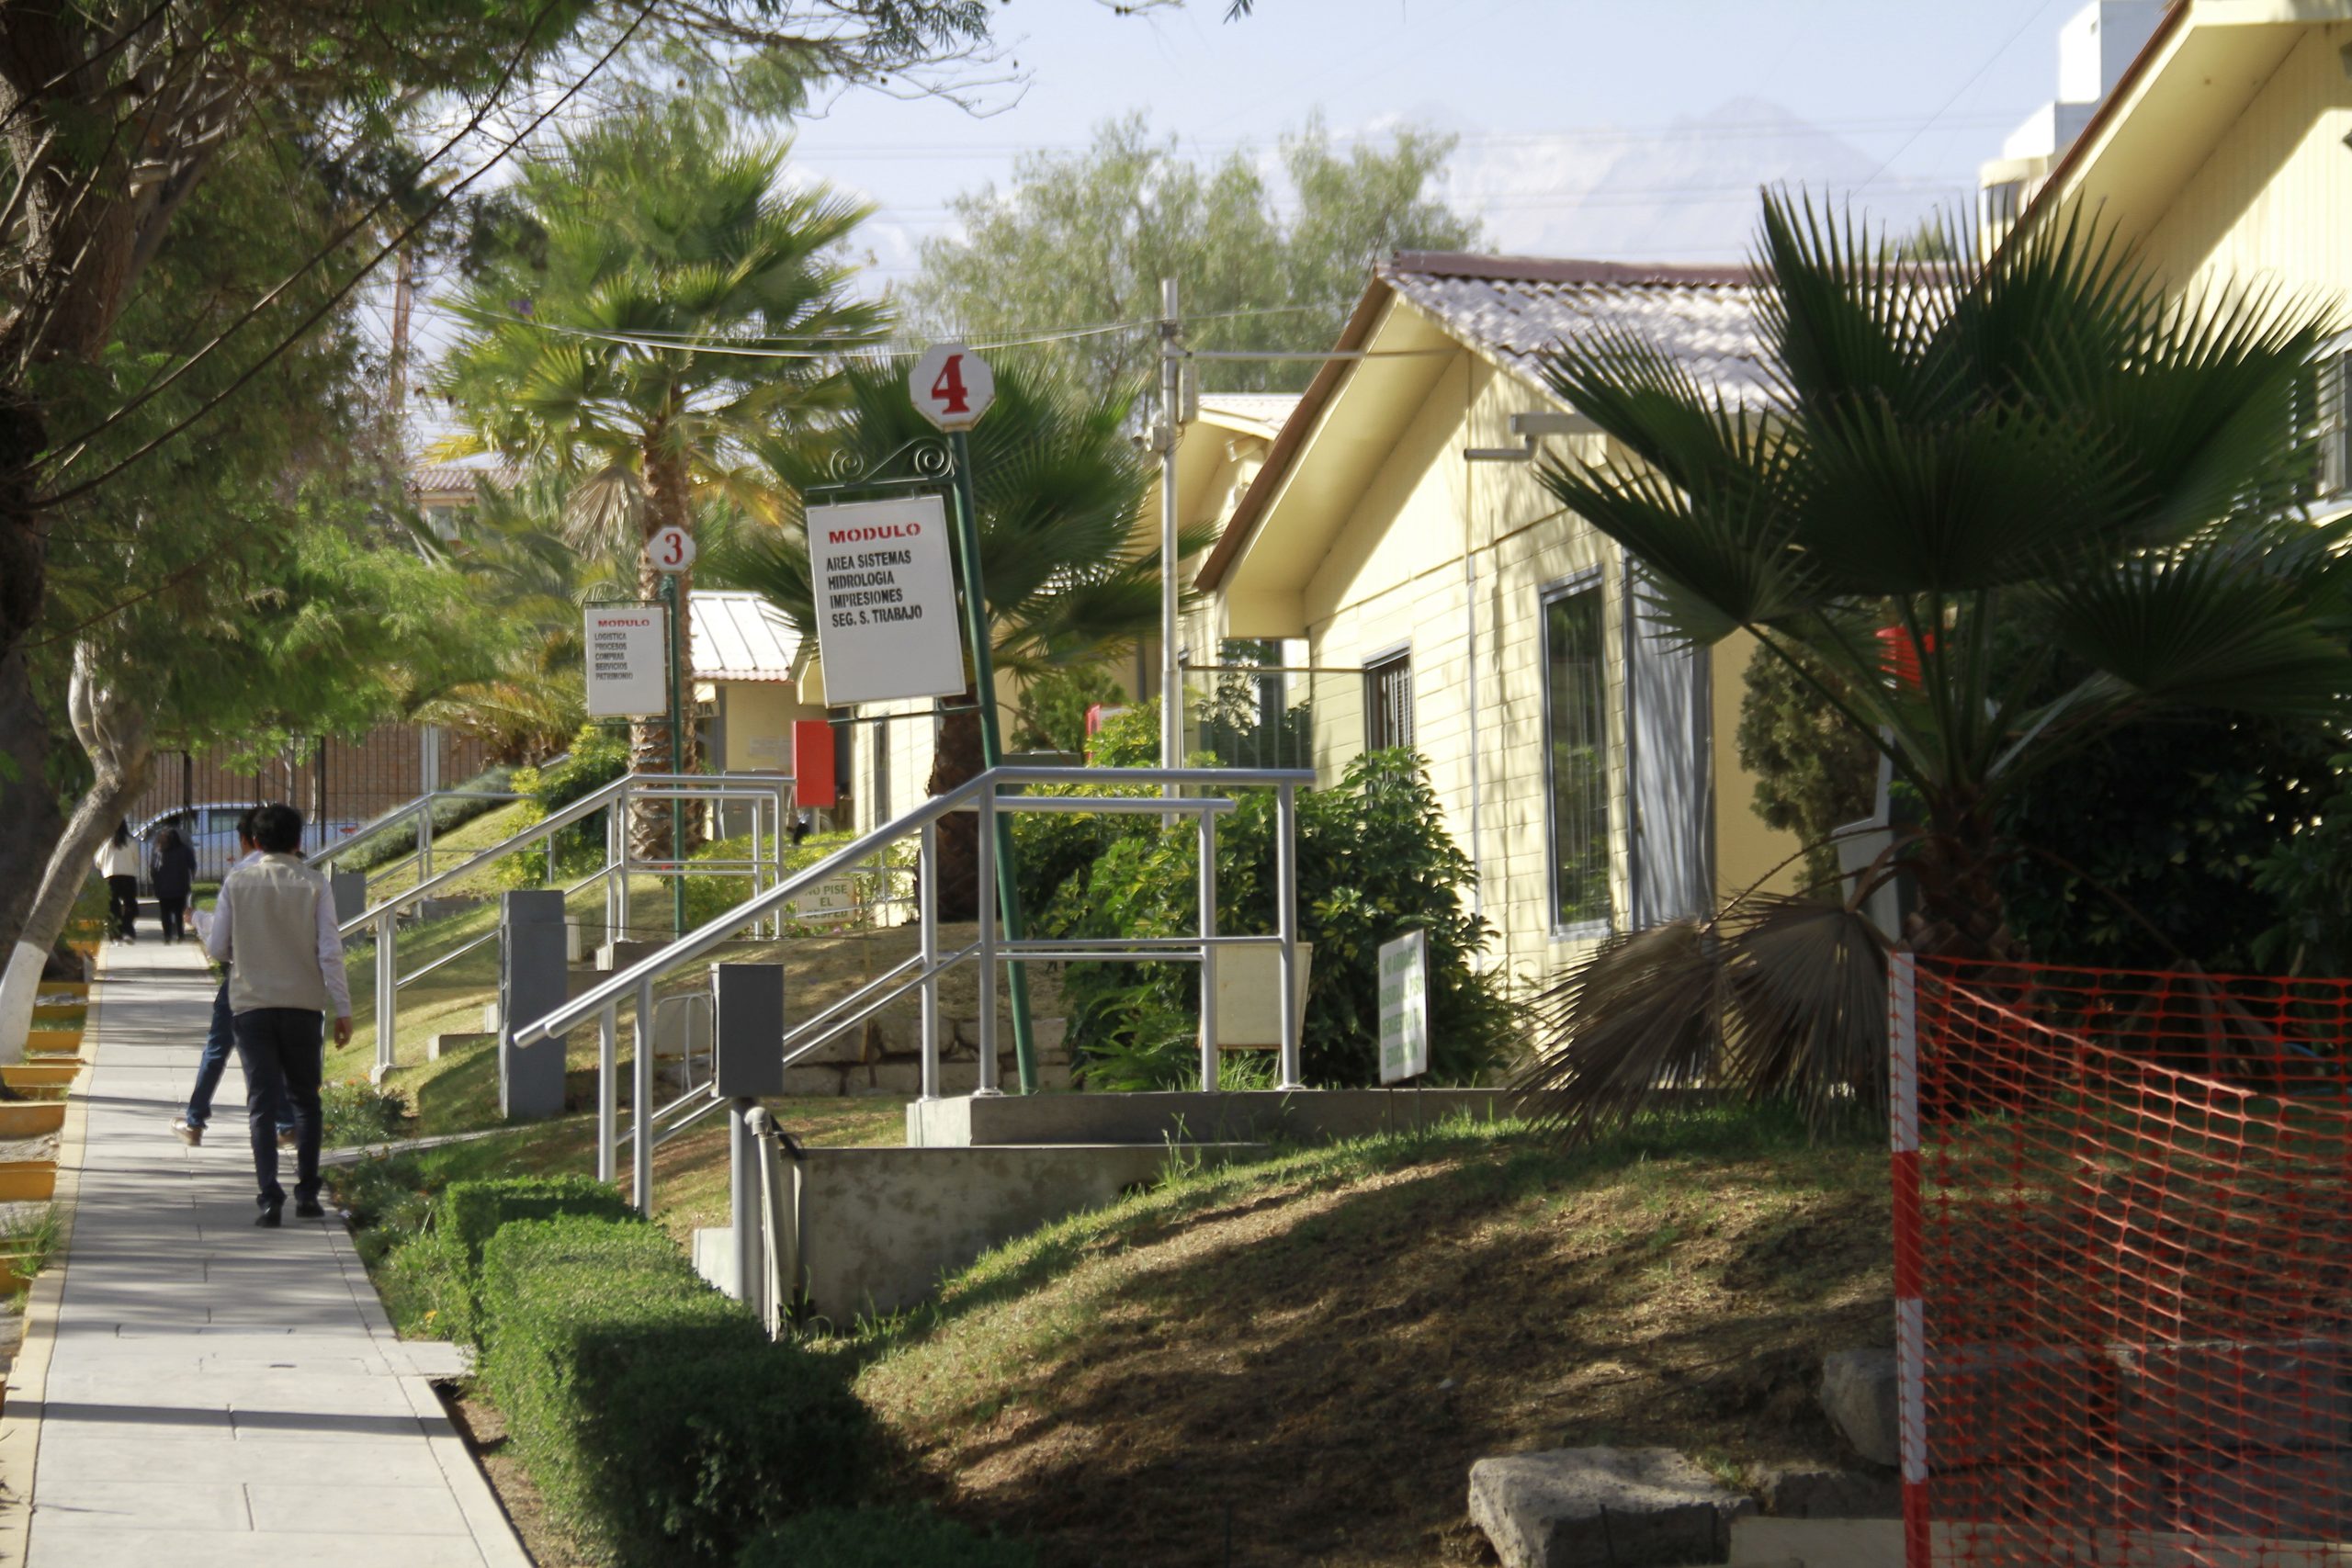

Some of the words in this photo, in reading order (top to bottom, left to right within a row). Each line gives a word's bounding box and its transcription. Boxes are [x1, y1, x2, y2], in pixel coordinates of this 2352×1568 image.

[931, 354, 970, 414] 4
[829, 523, 922, 544] MODULO
[663, 533, 684, 565] 3
[827, 556, 855, 571] AREA
[858, 549, 911, 569] SISTEMAS
[828, 570, 895, 591] HIDROLOGIA
[830, 588, 903, 609] IMPRESIONES
[597, 619, 650, 627] MODULO
[832, 611, 857, 627] SEG.
[860, 610, 870, 626] S.
[872, 604, 922, 624] TRABAJO
[594, 661, 628, 671] SERVICIOS
[823, 884, 847, 896] PISE
[820, 897, 833, 907] EL
